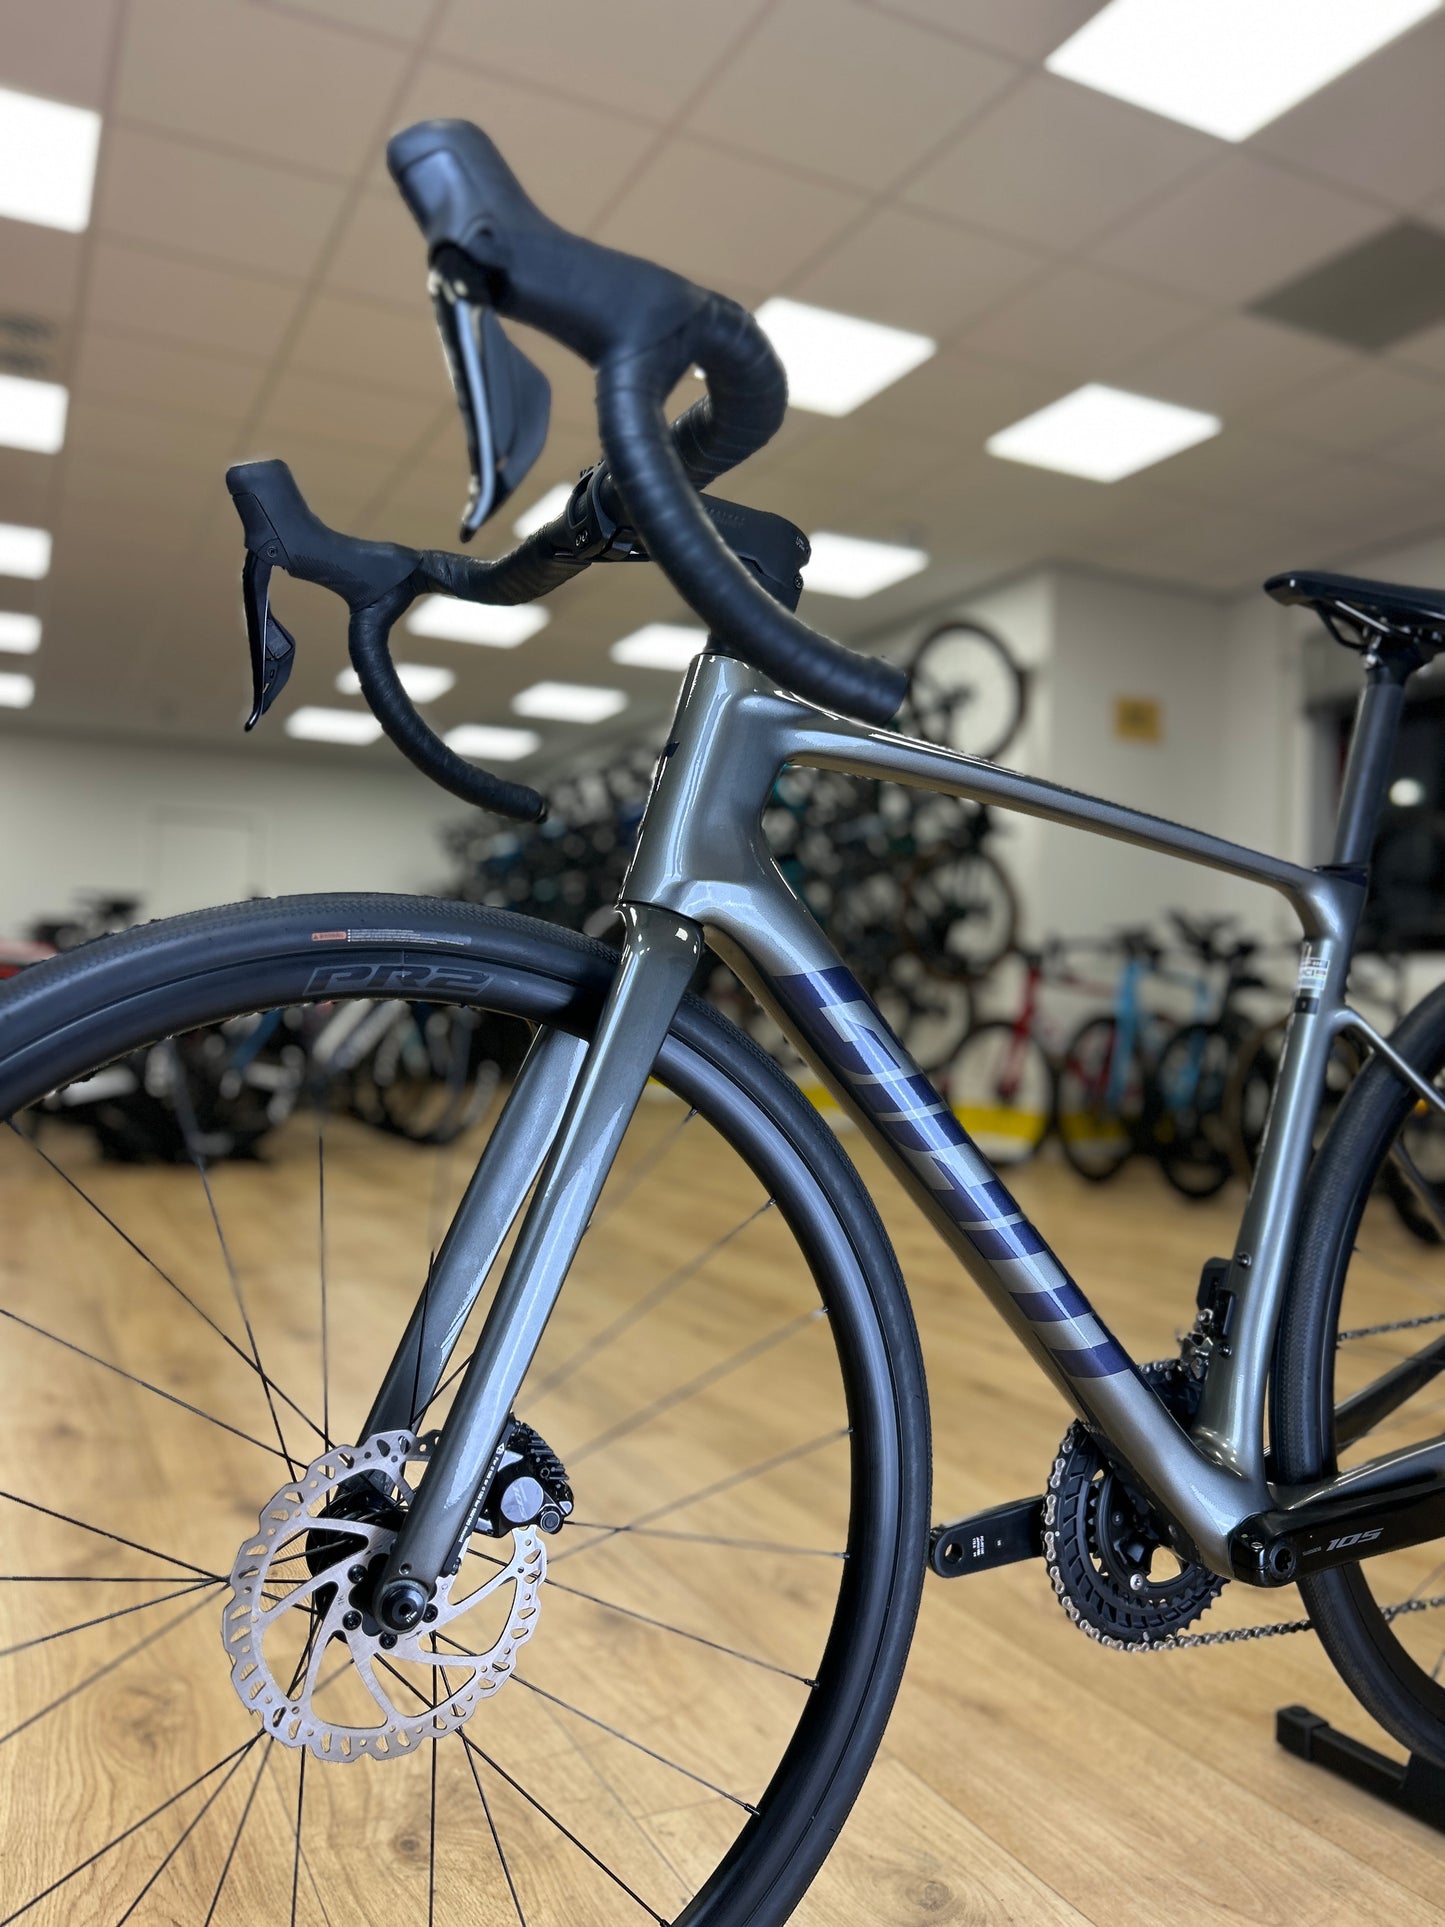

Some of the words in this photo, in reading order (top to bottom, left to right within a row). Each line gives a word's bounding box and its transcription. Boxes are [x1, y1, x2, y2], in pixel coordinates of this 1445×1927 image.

[306, 965, 490, 993] PR2
[772, 964, 1152, 1392] GIANT
[1326, 1527, 1385, 1552] 105
